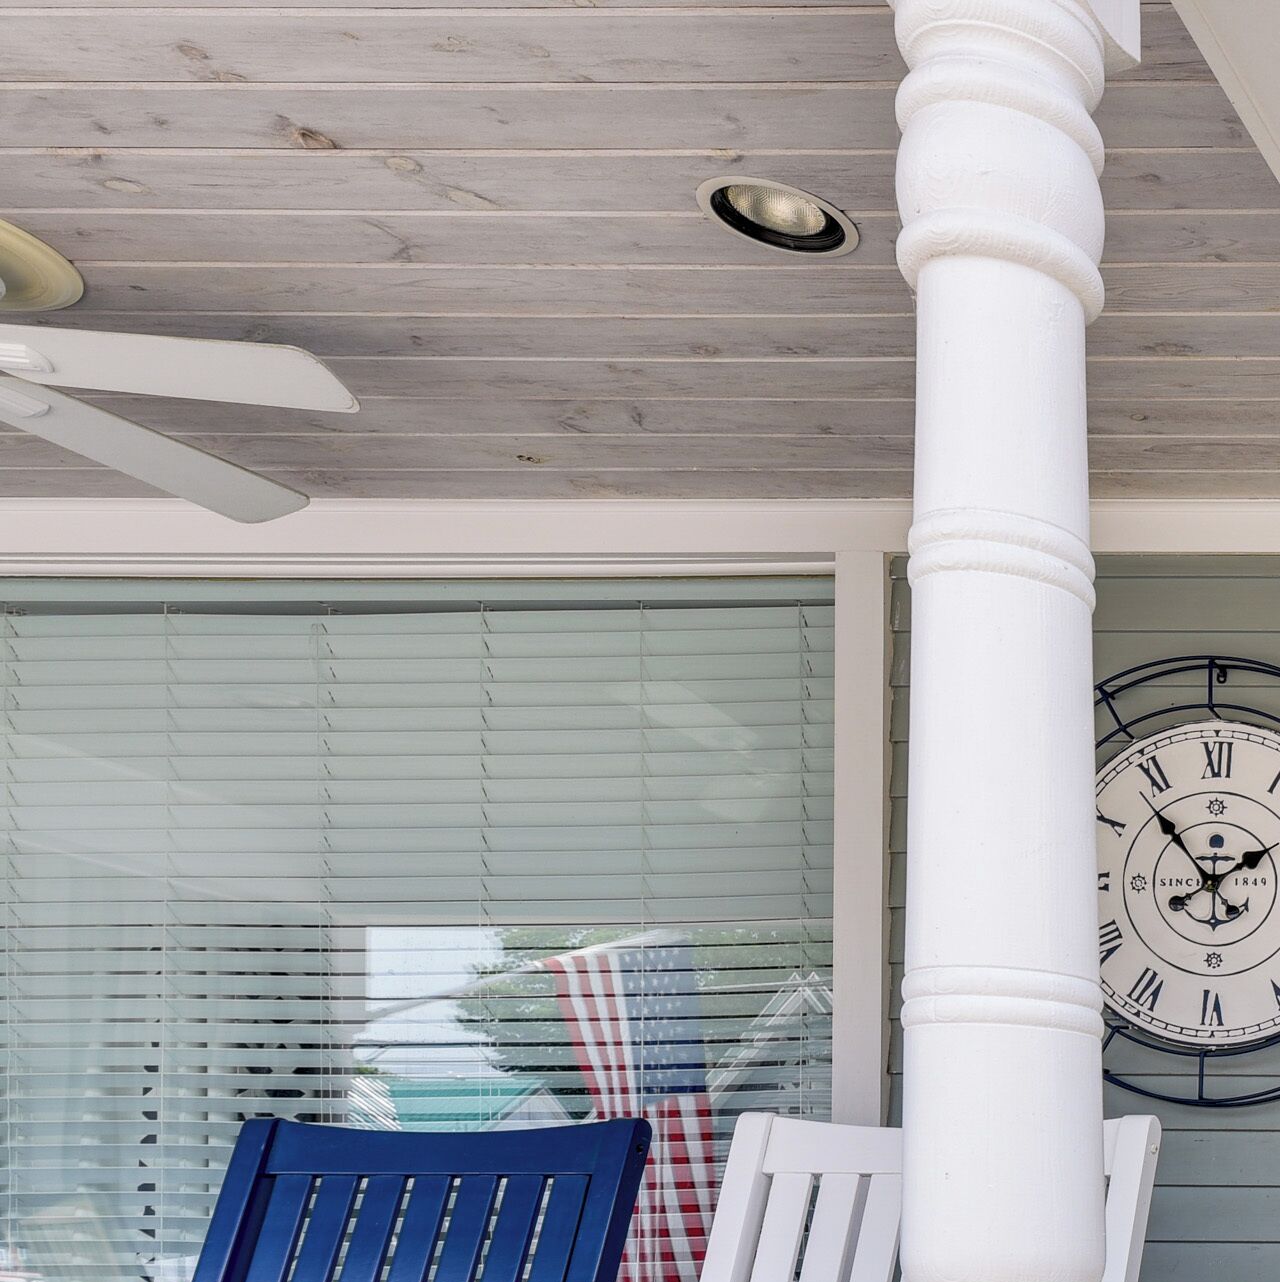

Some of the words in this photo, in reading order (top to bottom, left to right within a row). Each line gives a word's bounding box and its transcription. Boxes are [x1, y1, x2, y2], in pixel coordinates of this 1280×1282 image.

[1135, 755, 1174, 798] XI
[1200, 741, 1233, 779] XII
[1234, 877, 1267, 887] 1849
